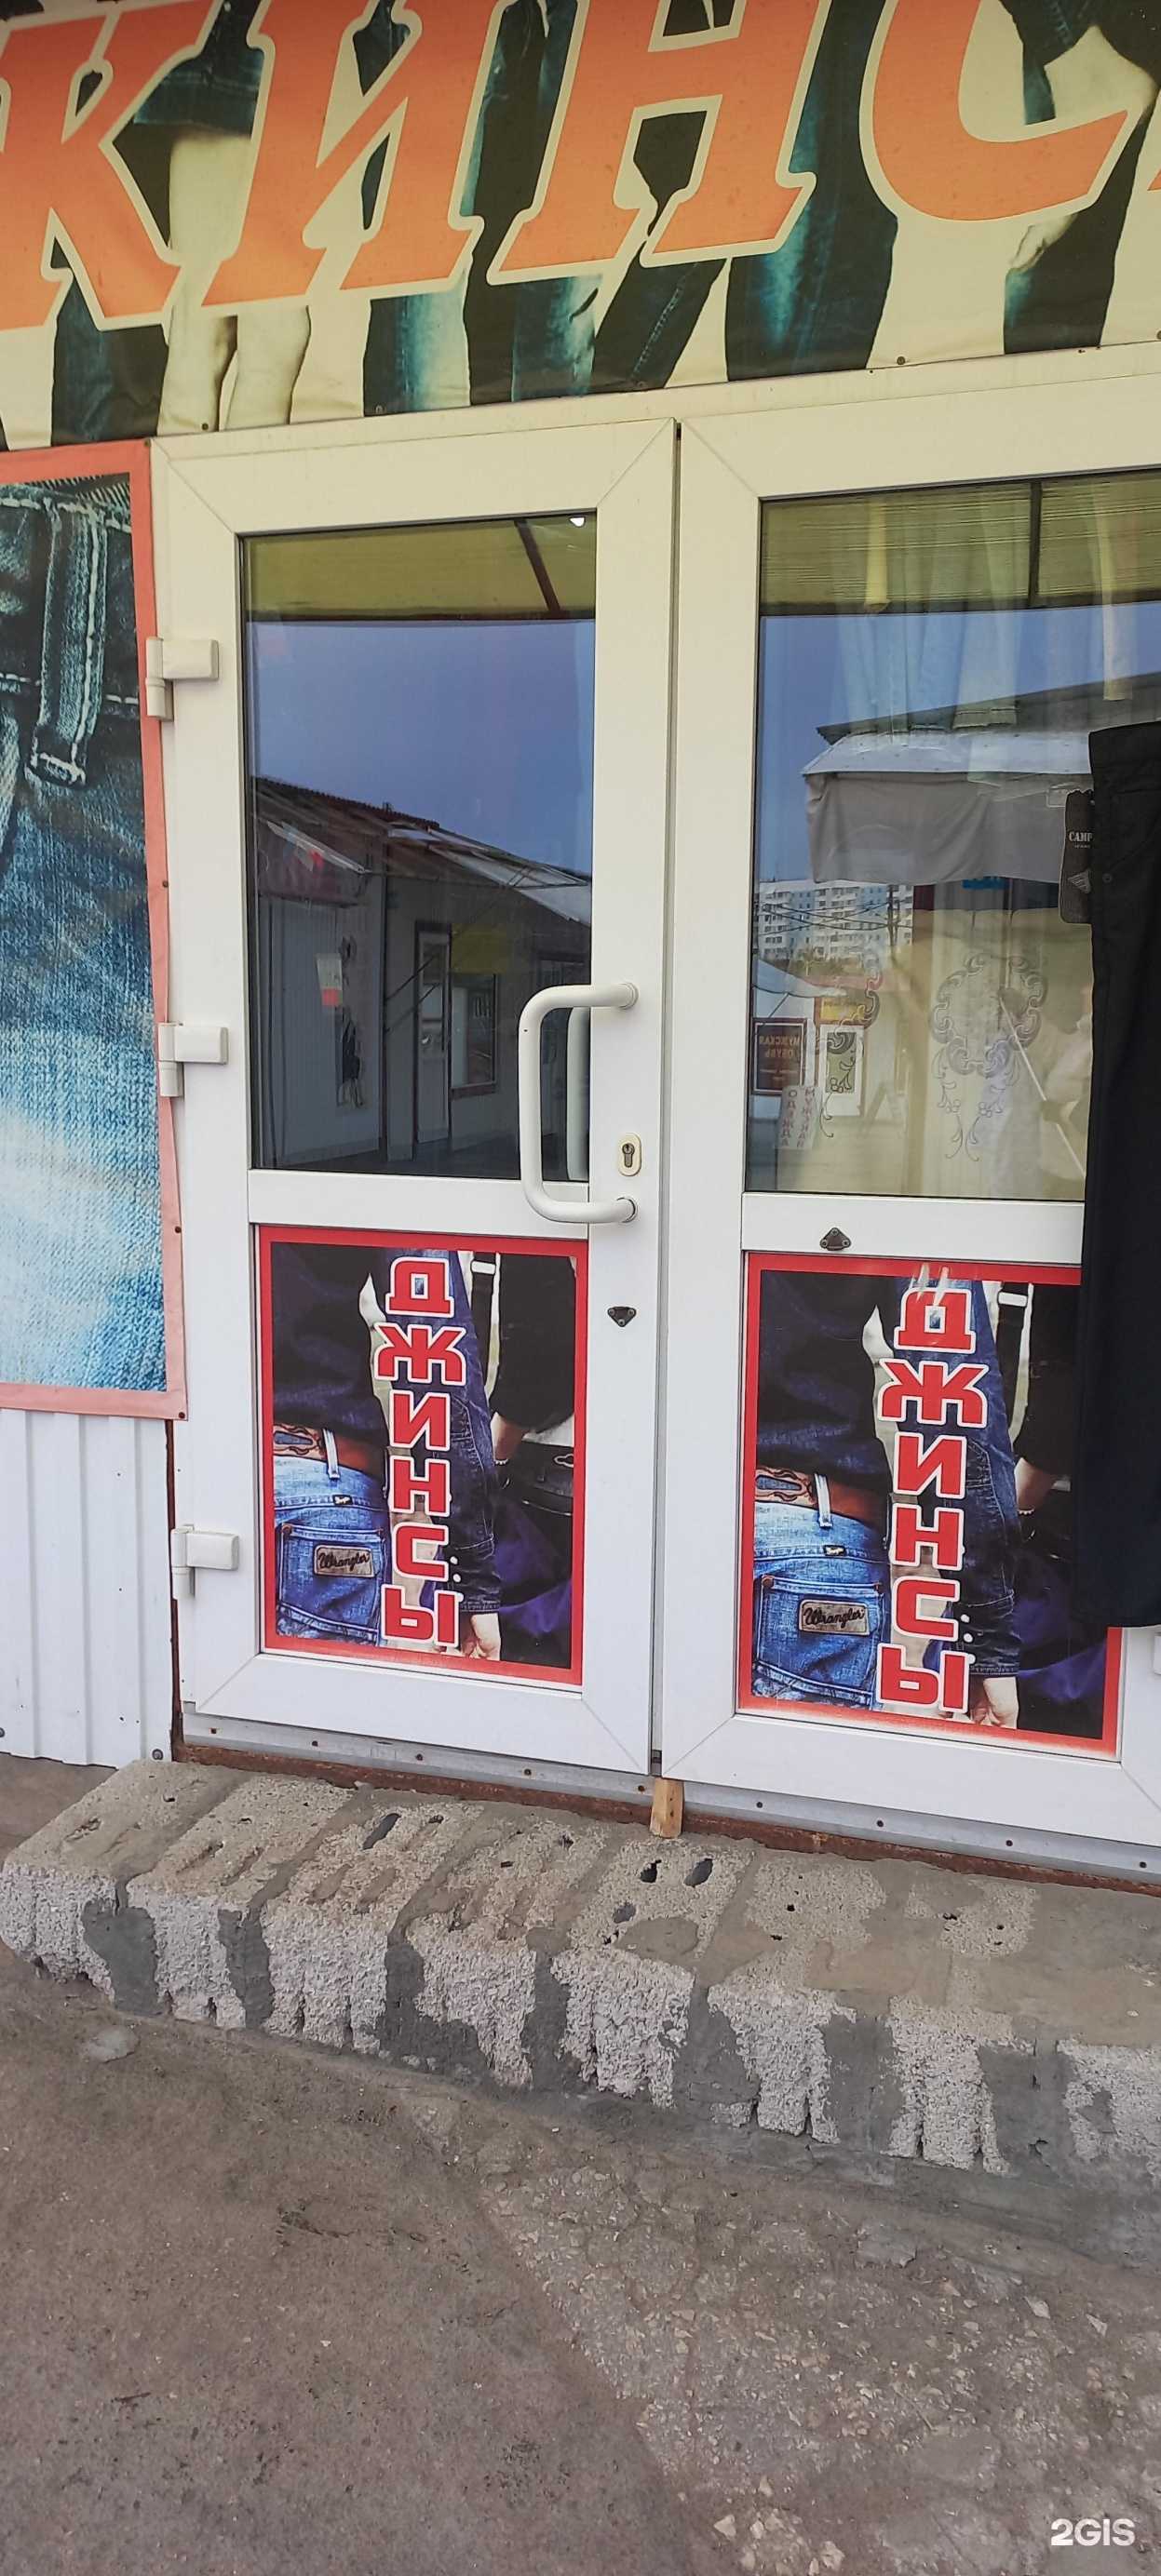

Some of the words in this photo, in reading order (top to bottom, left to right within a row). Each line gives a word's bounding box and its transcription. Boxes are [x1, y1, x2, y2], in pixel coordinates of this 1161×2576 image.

[373, 1257, 467, 1647] ДЖИНСЫ
[876, 1286, 989, 1714] ДЖИНСЫ
[317, 1551, 371, 1572] Wrangler
[803, 1607, 865, 1629] Wrangler
